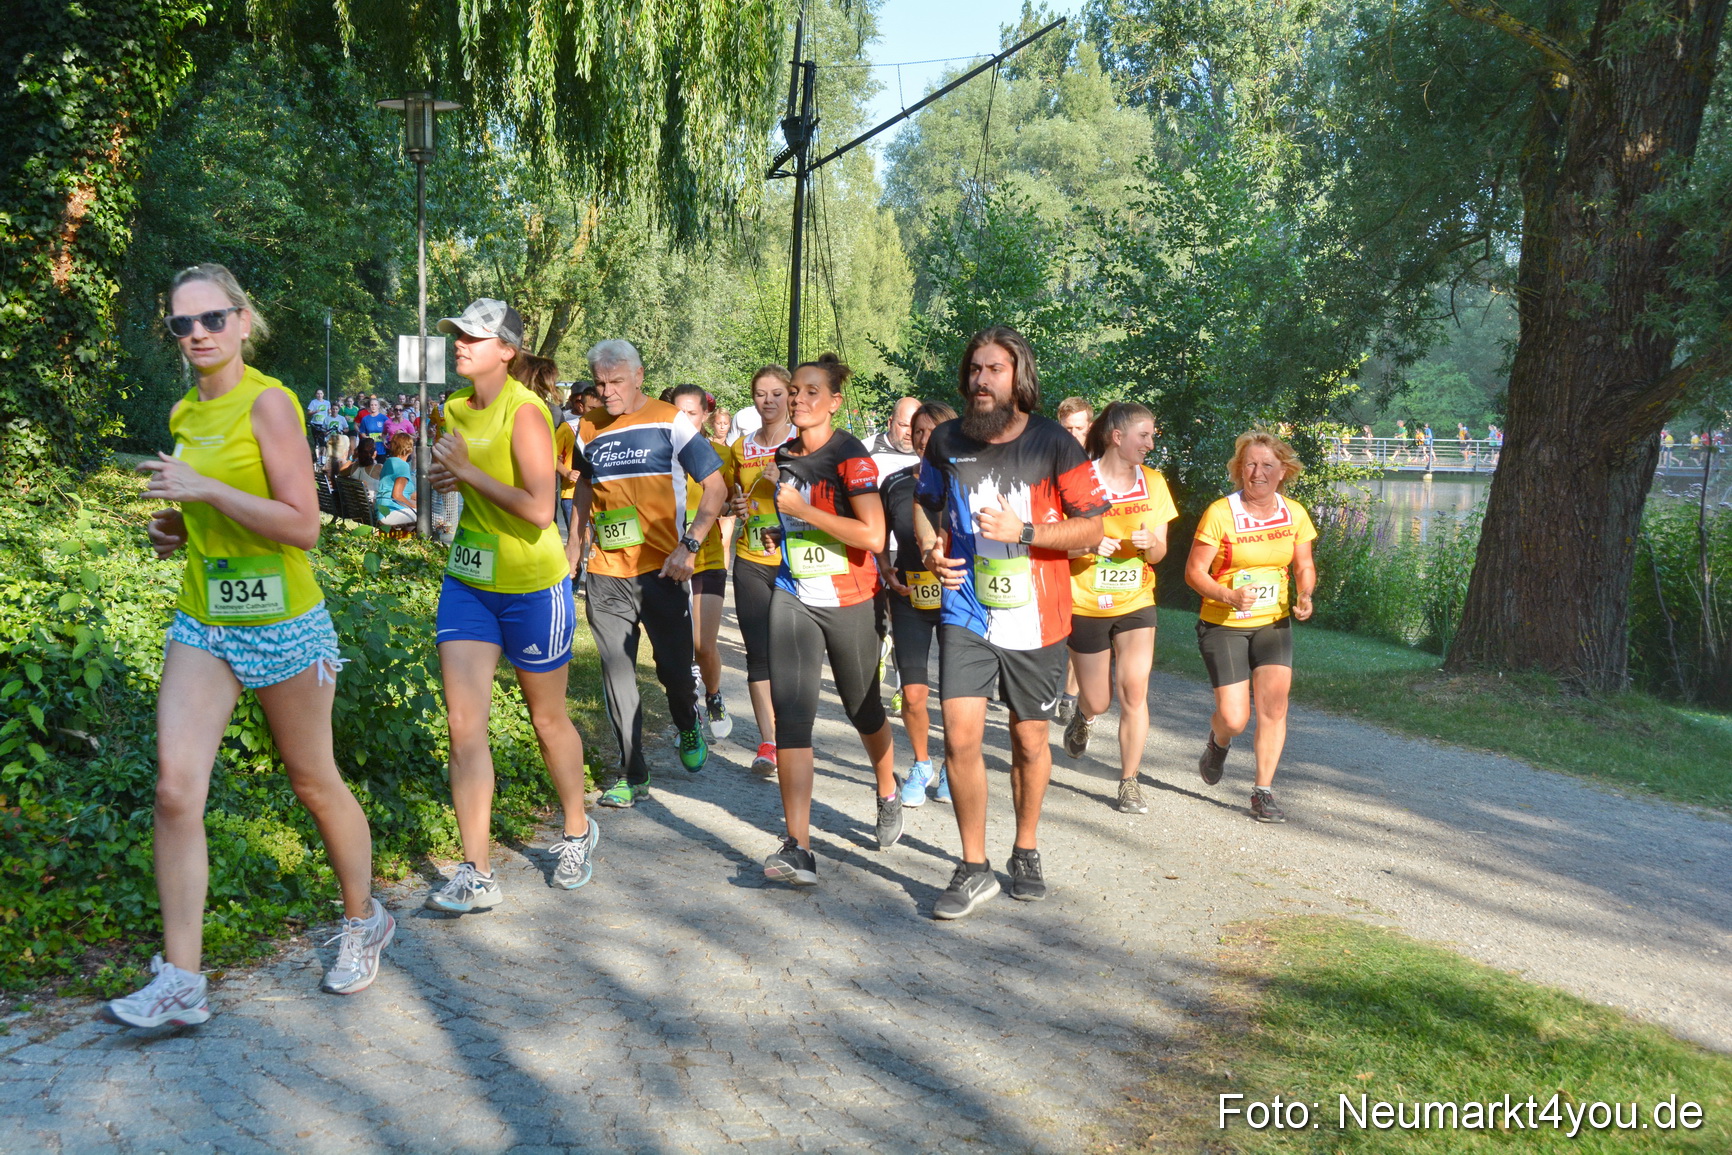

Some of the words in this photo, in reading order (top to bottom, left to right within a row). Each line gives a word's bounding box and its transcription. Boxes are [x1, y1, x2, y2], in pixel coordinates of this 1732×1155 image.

[599, 447, 651, 462] Fischer
[603, 458, 646, 468] AUTOMOBILE
[1101, 508, 1121, 517] AX
[1125, 503, 1153, 515] BÖGL
[604, 522, 627, 538] 587
[1236, 534, 1264, 544] MAX
[1267, 529, 1294, 540] BÖGL
[454, 545, 482, 568] 904
[803, 546, 825, 563] 40
[1100, 569, 1137, 582] 1223
[220, 579, 267, 603] 934
[913, 584, 940, 598] 168
[988, 576, 1011, 593] 43
